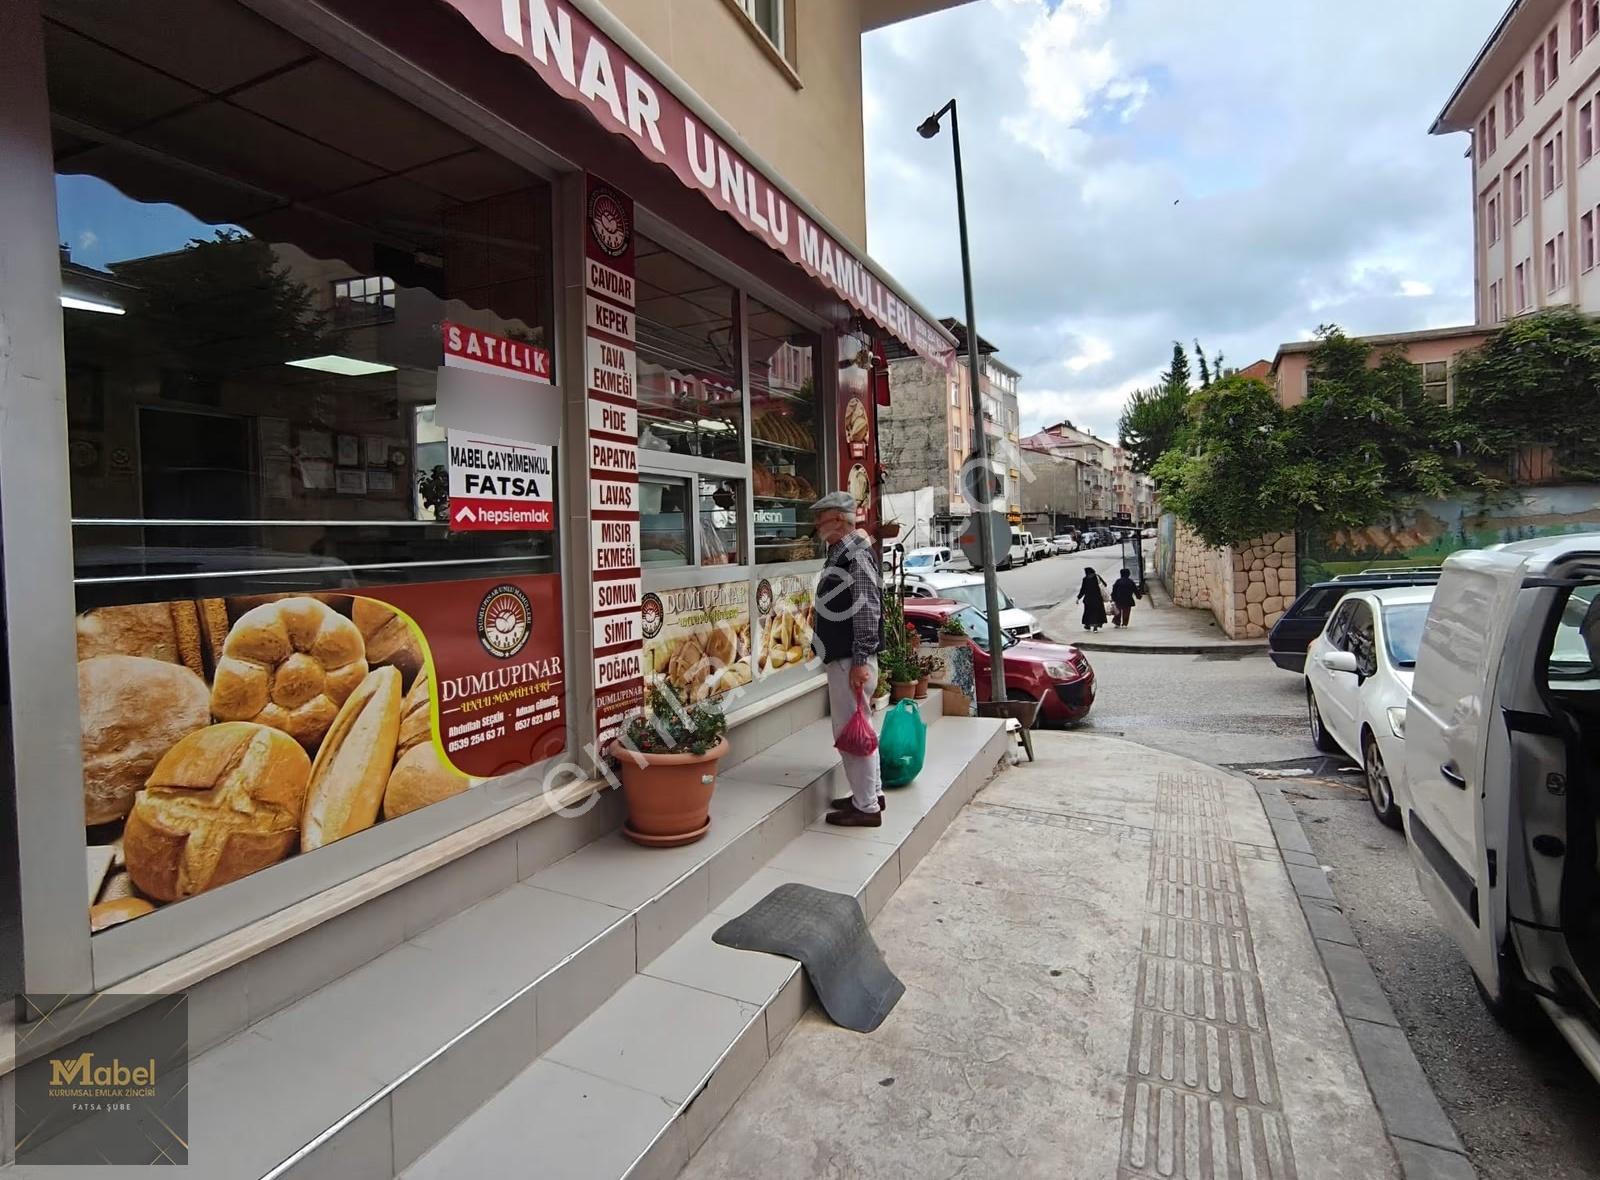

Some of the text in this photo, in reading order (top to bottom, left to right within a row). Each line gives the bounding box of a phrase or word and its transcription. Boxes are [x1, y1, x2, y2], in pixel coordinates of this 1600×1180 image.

[684, 116, 788, 245] UNLU
[798, 215, 912, 341] MAMÜLLERİ
[591, 263, 631, 300] ÇAVDAR
[595, 303, 628, 335] KEPEK
[449, 327, 546, 373] SATILIK
[600, 344, 625, 370] TAVA
[593, 367, 632, 396] EKMEĞİ
[602, 405, 626, 432] PİDE
[450, 446, 550, 475] MABEL GAYRİMENKUL
[593, 445, 637, 470] PAPATYA
[465, 474, 540, 497] FATSA
[599, 484, 631, 508] LAVAŞ
[478, 507, 549, 525] hepsiemlak
[601, 522, 631, 543] MISIR
[597, 544, 635, 568] EKMEĞİ
[598, 583, 637, 607] SOMUN
[604, 617, 632, 644] SİMİT
[441, 656, 562, 702] DUMLUPINAR
[599, 656, 640, 684] POĞAÇA
[496, 726, 505, 737] 71
